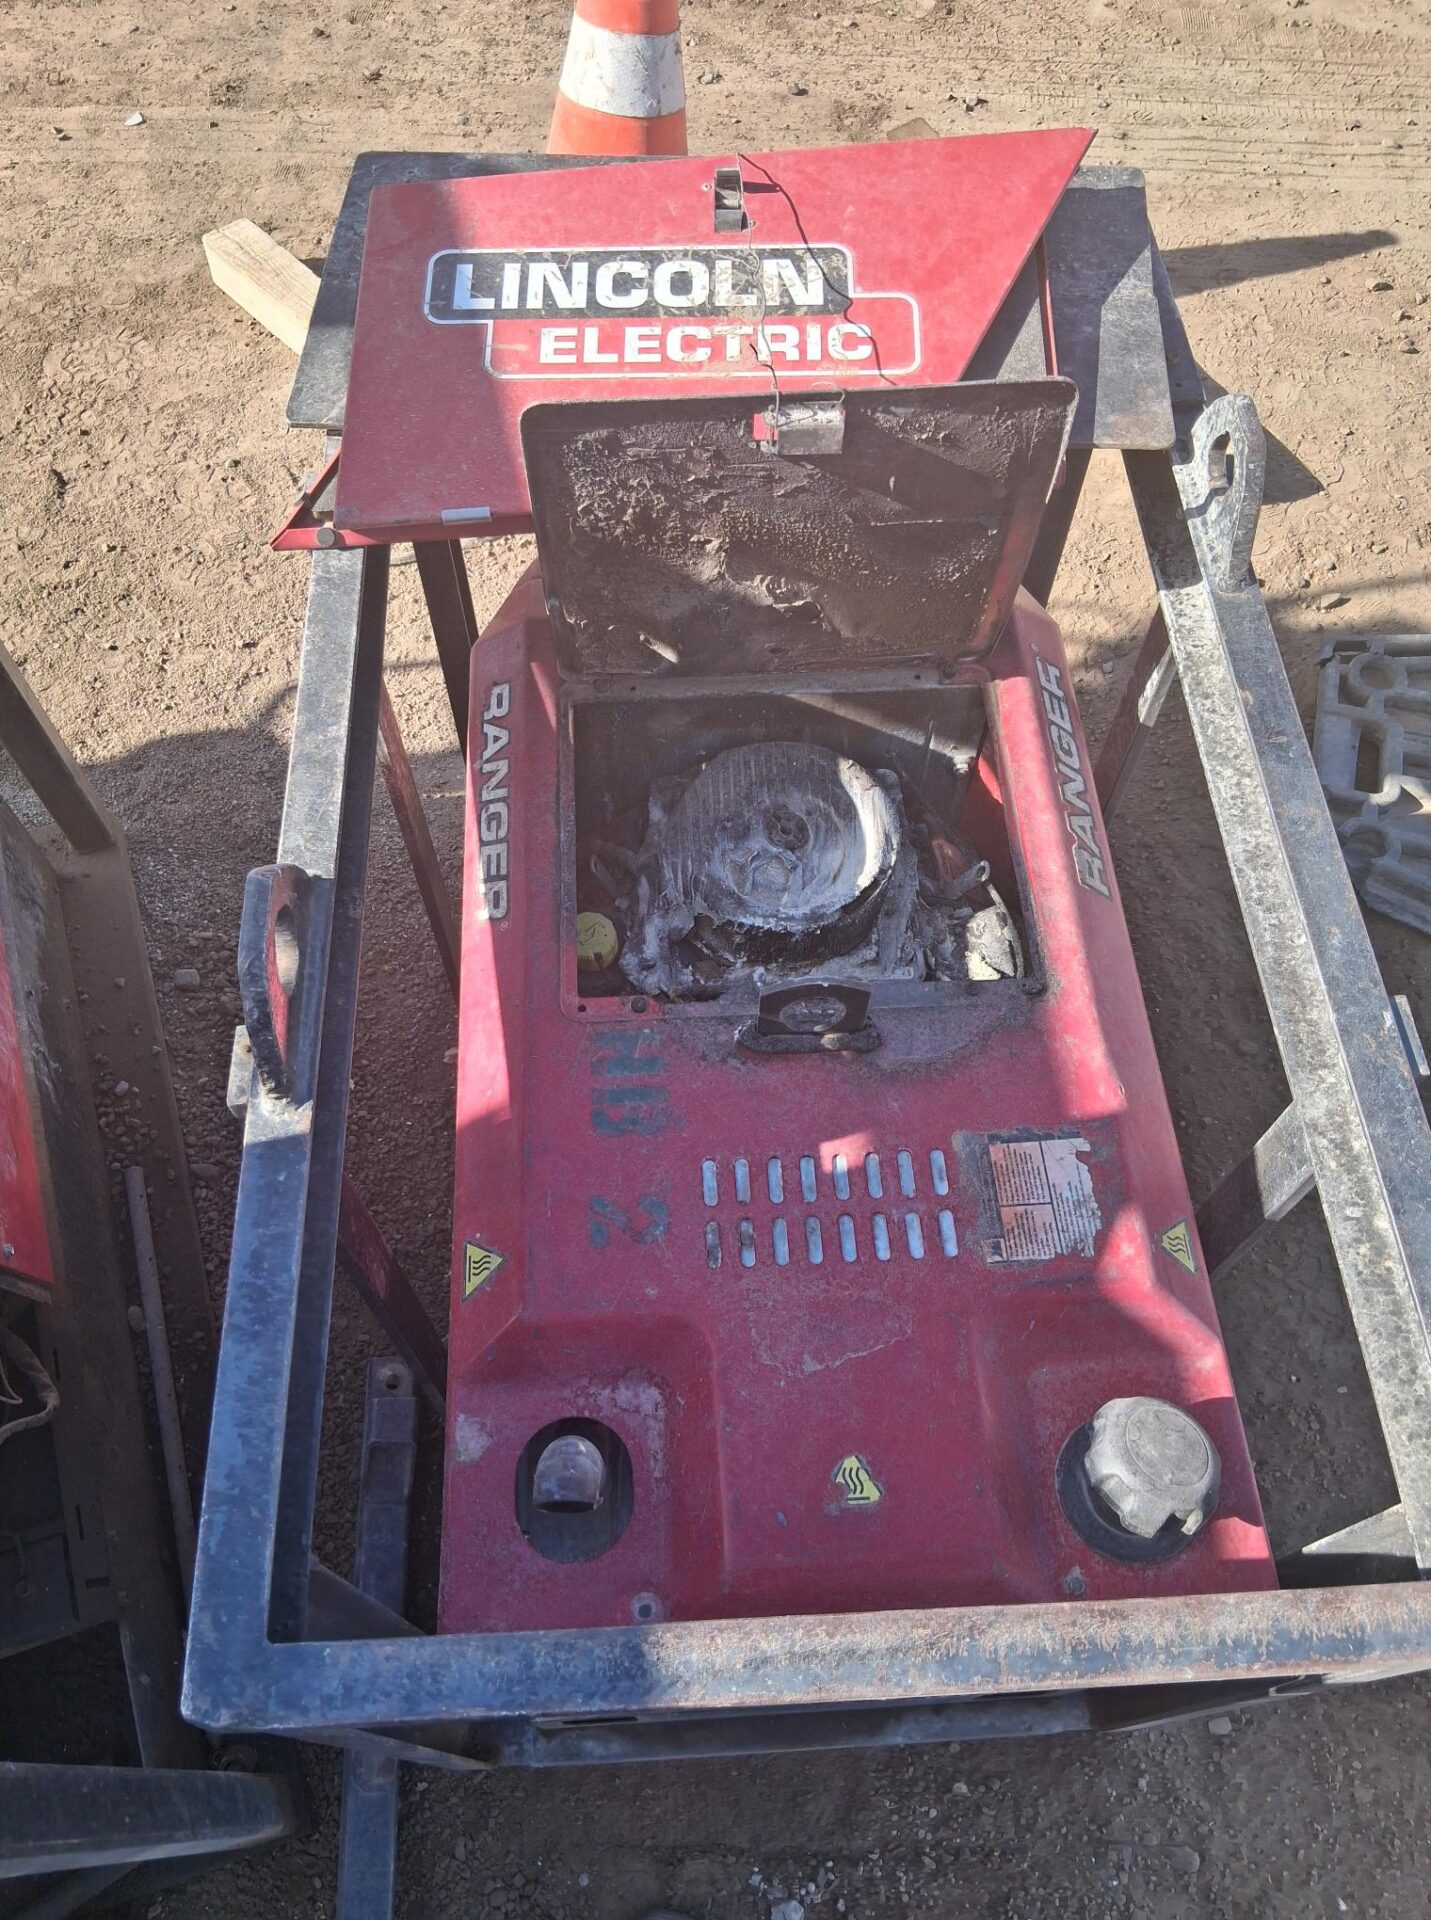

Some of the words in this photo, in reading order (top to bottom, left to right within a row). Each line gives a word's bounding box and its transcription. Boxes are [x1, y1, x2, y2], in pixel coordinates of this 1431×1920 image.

[452, 258, 825, 311] LINCOLN
[538, 323, 873, 365] ELECTRIC
[477, 682, 512, 922] RANGER
[1036, 655, 1110, 898] RANGER
[590, 1194, 670, 1248] 2
